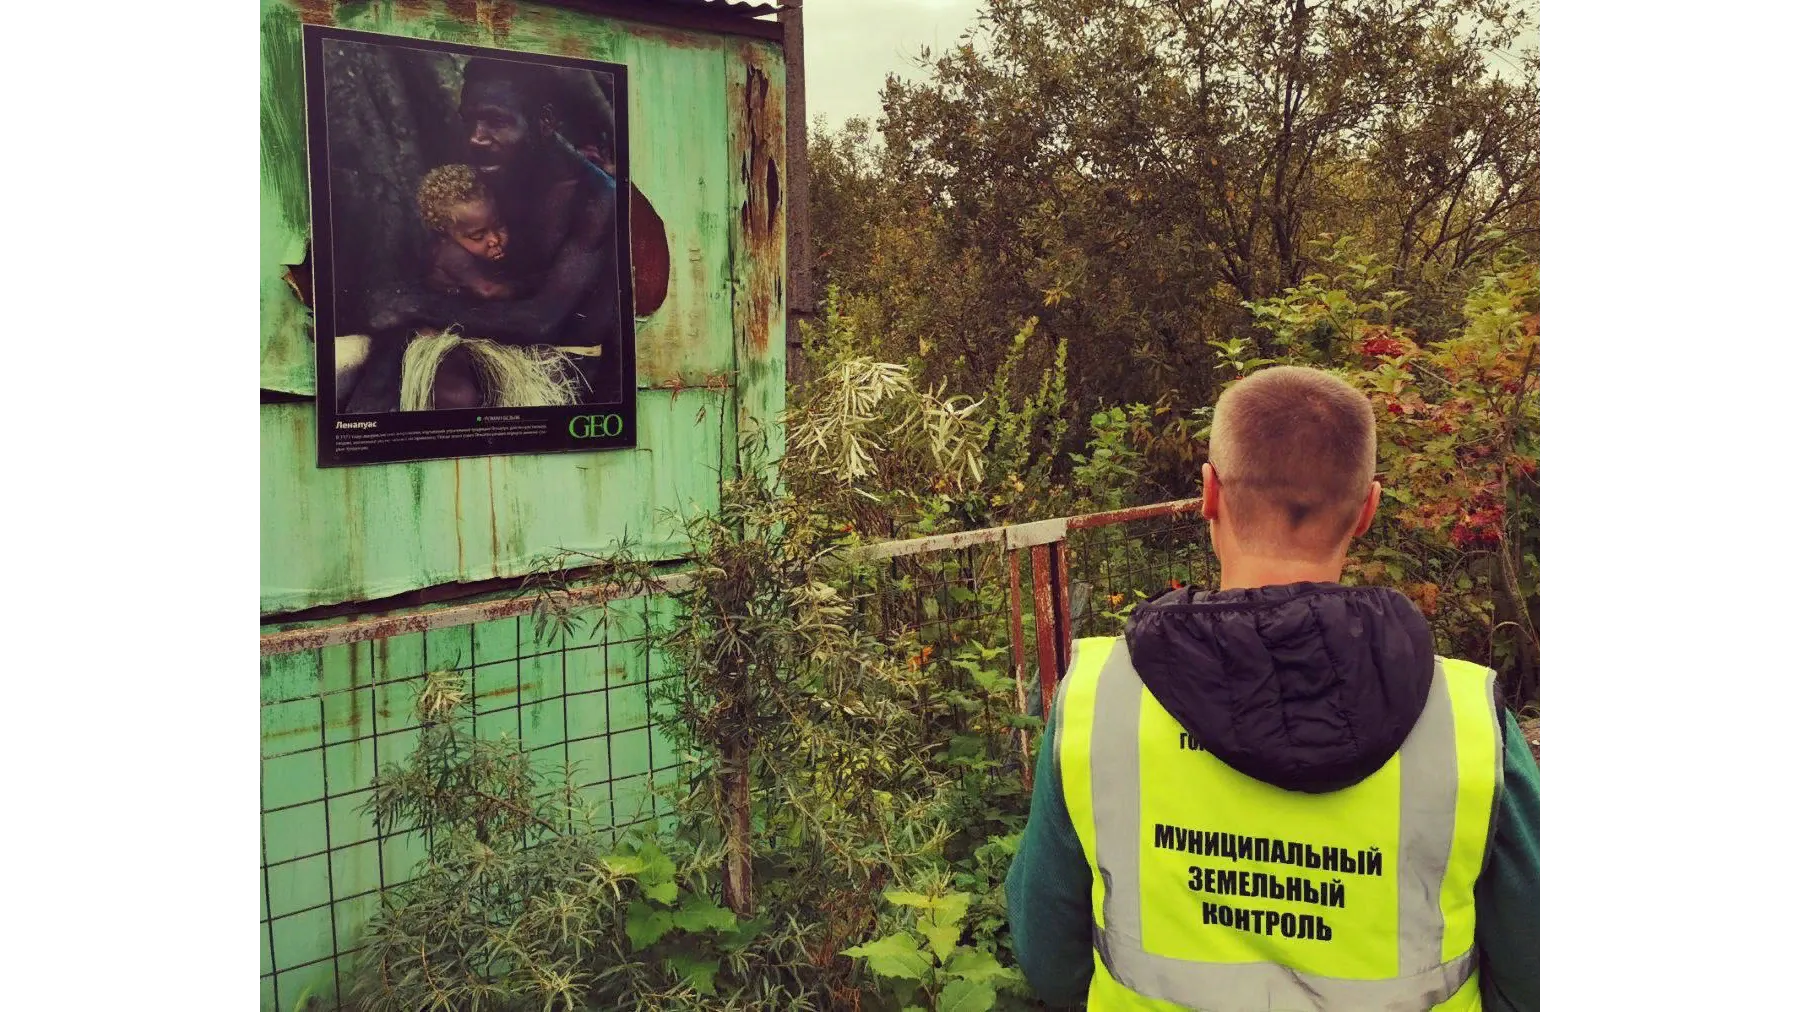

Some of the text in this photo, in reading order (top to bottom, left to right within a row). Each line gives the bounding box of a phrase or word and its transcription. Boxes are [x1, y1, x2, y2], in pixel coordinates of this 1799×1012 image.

[569, 414, 623, 438] GEO
[1154, 823, 1383, 876] МУНИЦИПАЛЬНЫЙ
[1188, 865, 1345, 908] ЗЕМЕЛЬНЫЙ
[1202, 901, 1332, 942] КОНТРОЛЬ
